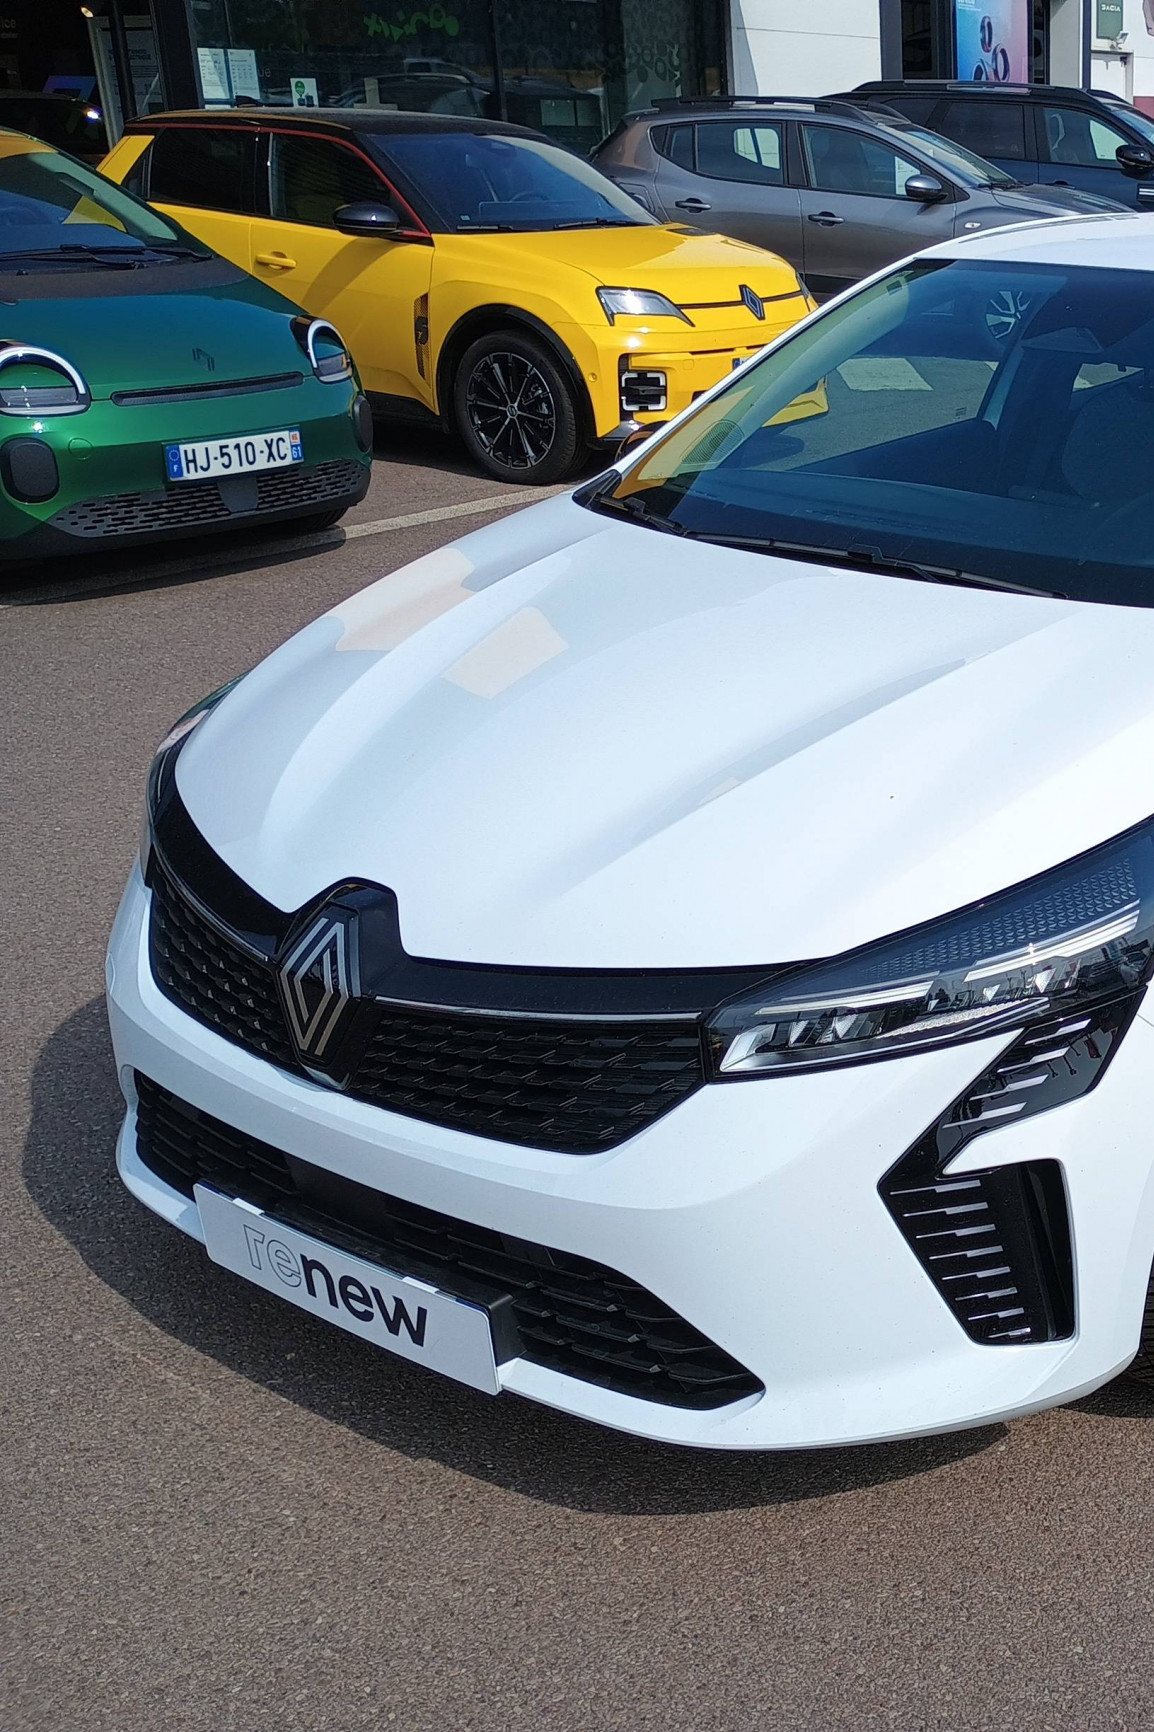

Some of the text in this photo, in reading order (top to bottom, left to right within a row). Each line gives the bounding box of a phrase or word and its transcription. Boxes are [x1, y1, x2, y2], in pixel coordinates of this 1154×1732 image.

[184, 437, 288, 474] HJ-510-XC
[292, 446, 302, 458] 61
[244, 1225, 427, 1346] renew
